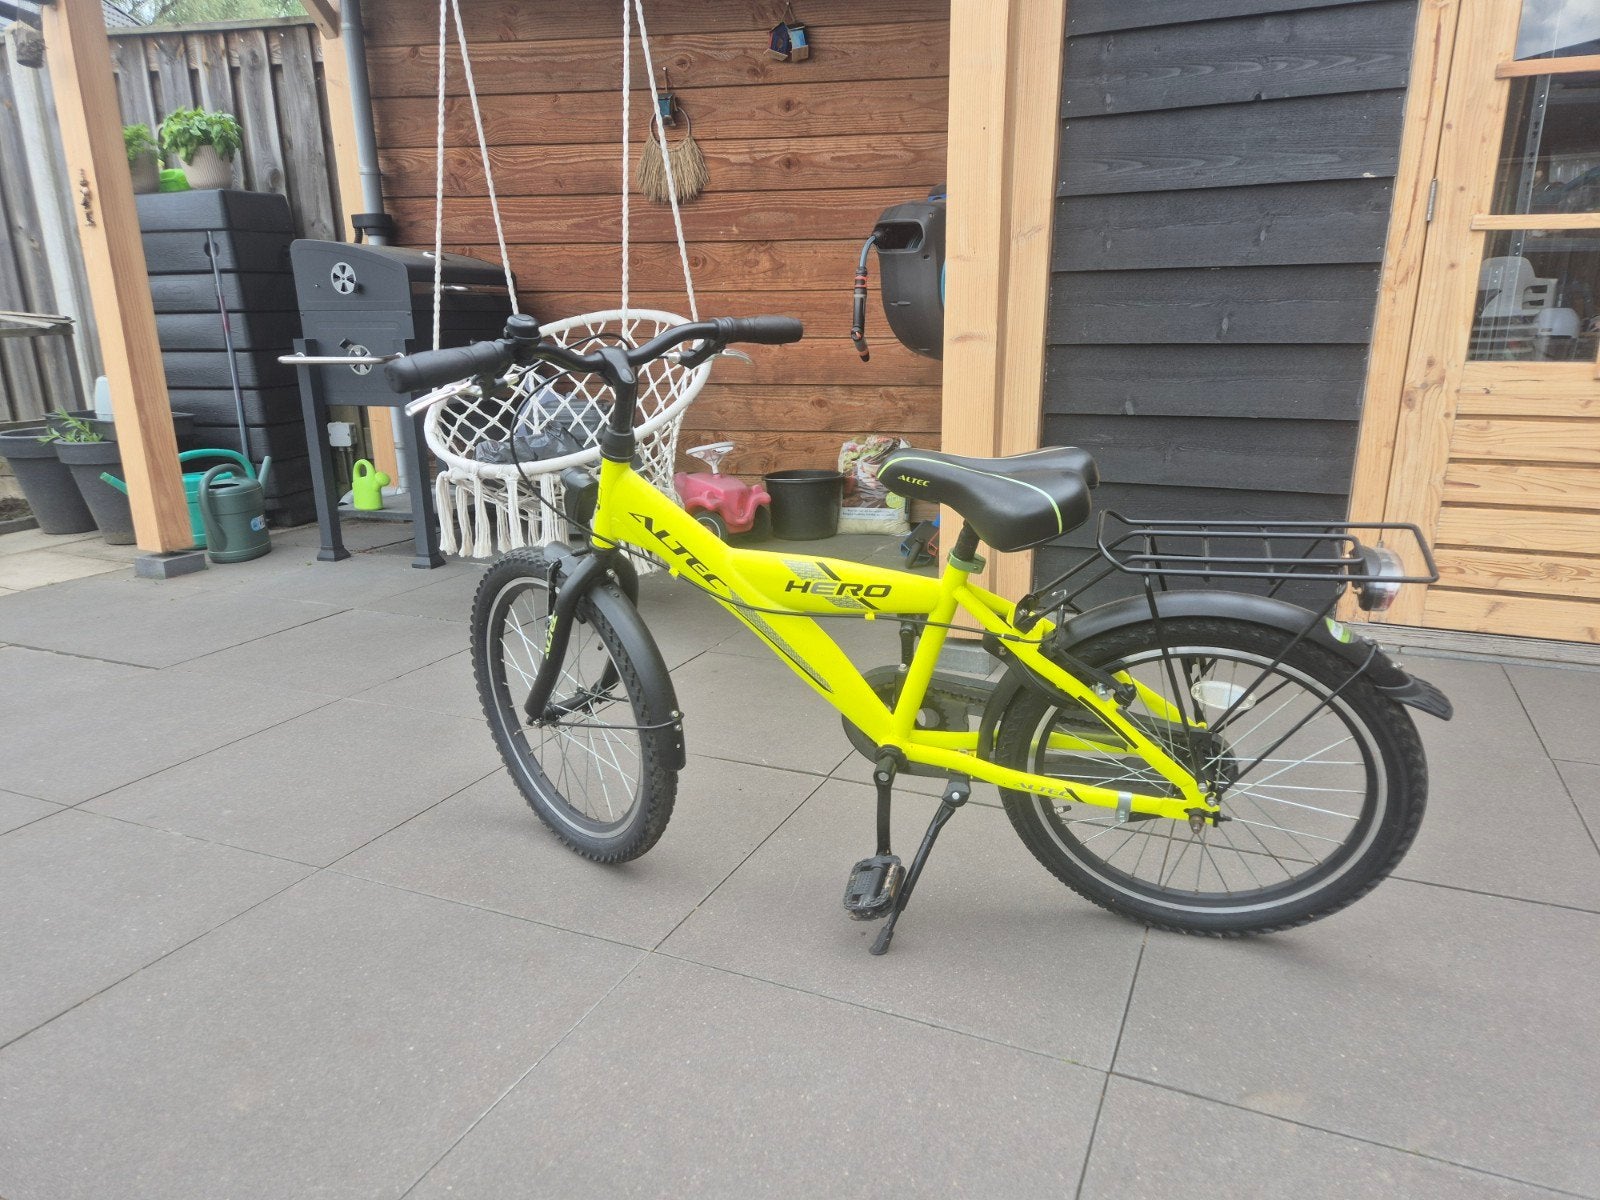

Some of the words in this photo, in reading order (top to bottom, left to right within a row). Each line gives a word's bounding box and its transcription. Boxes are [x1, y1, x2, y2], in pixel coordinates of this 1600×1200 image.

[898, 474, 930, 486] ALTEC
[627, 511, 728, 590] ALTEC
[784, 580, 893, 598] HERO
